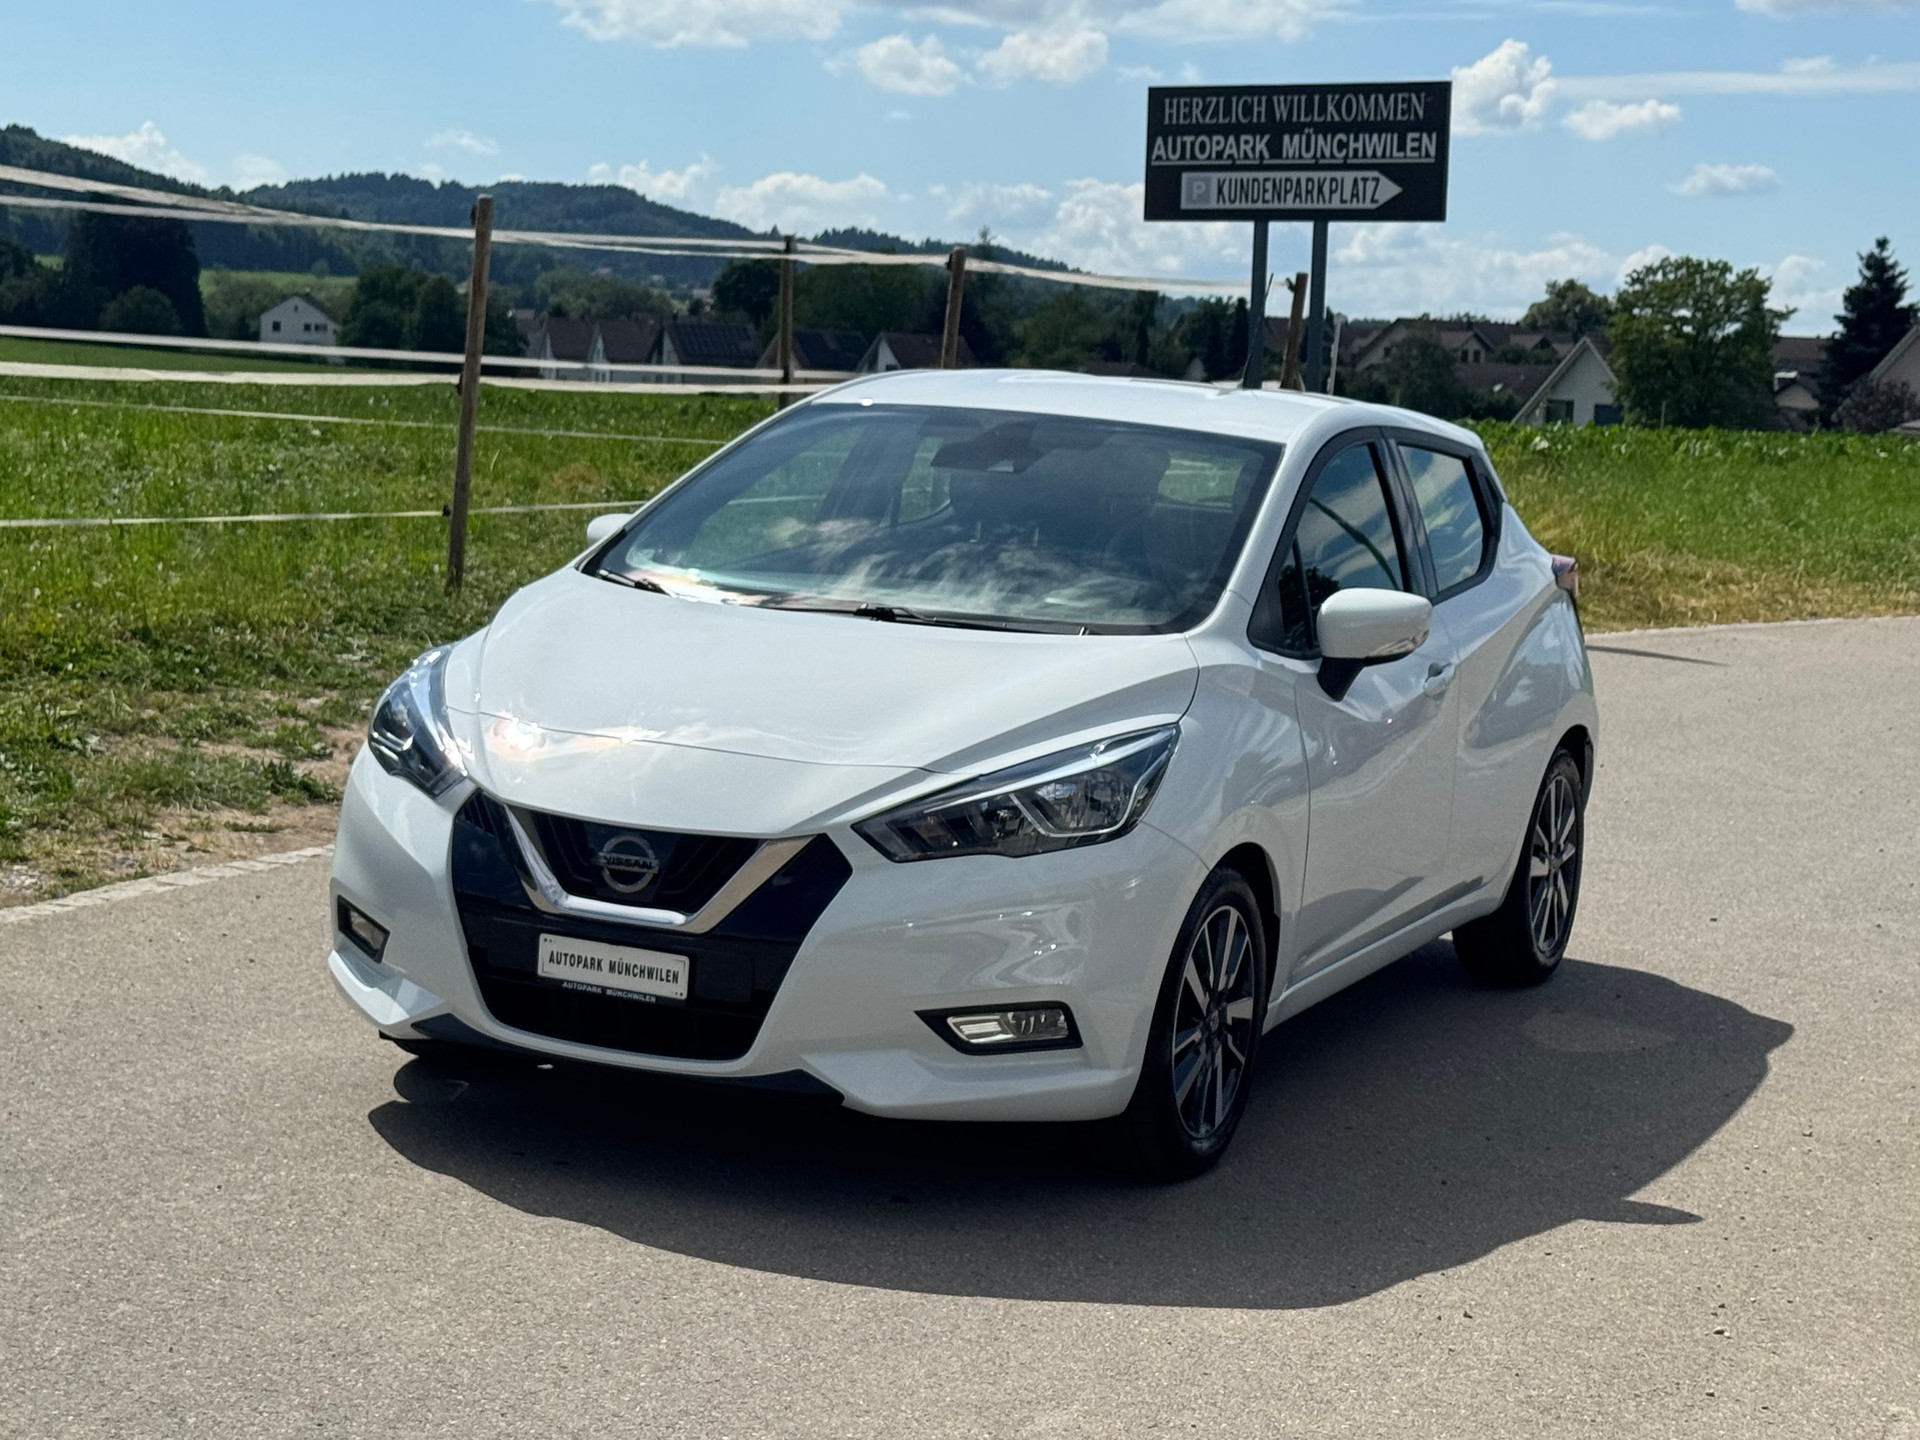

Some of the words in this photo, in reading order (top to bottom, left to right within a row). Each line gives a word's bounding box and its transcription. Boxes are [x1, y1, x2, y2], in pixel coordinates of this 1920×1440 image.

[1164, 95, 1266, 125] HERZLICH
[1273, 92, 1425, 123] WILLKOMMEN
[1151, 133, 1271, 161] AUTOPARK
[1282, 128, 1437, 160] MÜNCHWILEN
[1192, 181, 1206, 197] P
[1217, 176, 1380, 205] KUNDENPARKPLATZ
[602, 856, 654, 870] NISSAN
[549, 950, 603, 972] AUTOPARK
[608, 957, 679, 984] MÜNCHWILEN
[562, 981, 602, 994] AUTOPARK
[606, 987, 656, 1003] MÜNCHWILEN
